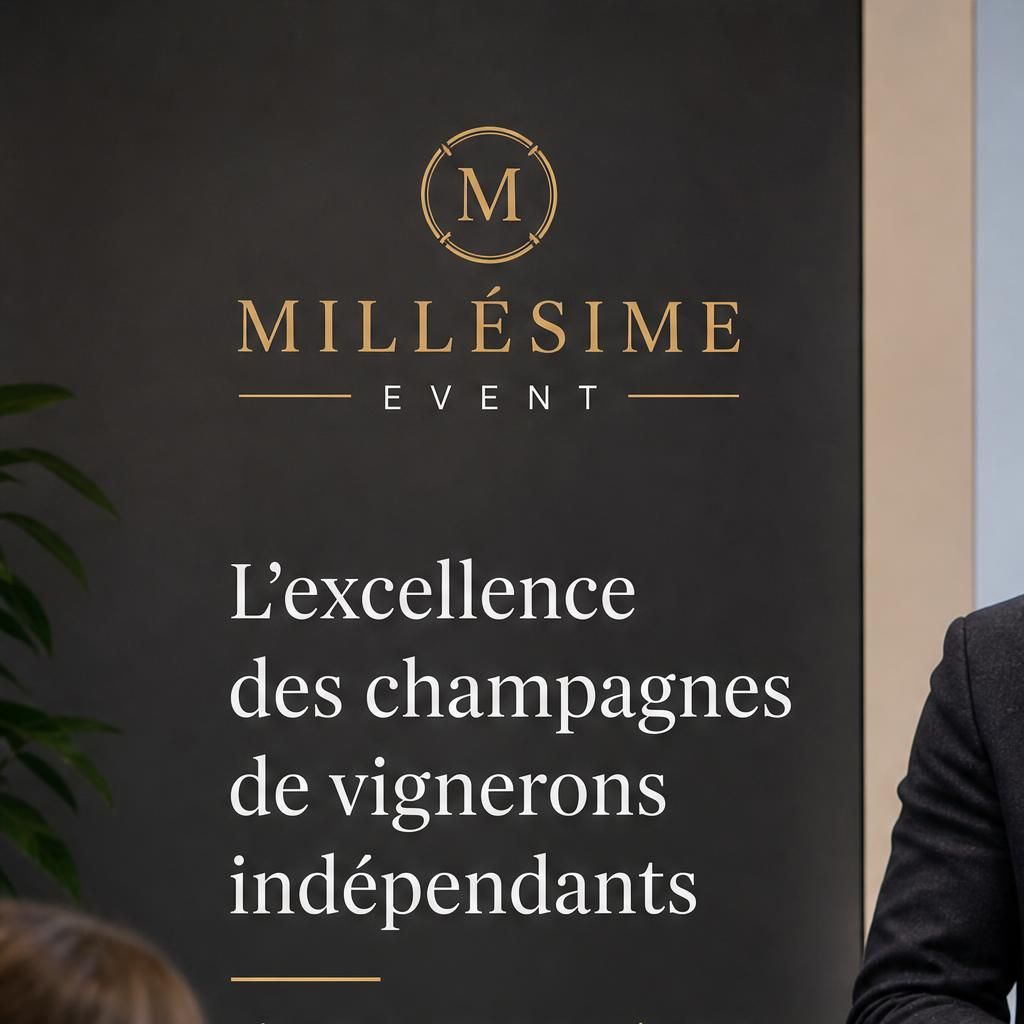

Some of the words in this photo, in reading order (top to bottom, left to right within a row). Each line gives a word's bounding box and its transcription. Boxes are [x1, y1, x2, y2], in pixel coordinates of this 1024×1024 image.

[458, 168, 521, 221] M
[238, 286, 740, 353] MILLÉSIME
[385, 385, 597, 409] EVENT
[231, 558, 635, 620] L’excellence
[231, 656, 342, 718] des
[367, 656, 791, 734] champagnes
[231, 754, 308, 816] de
[329, 757, 666, 832] vignerons
[230, 853, 697, 930] indépendants
